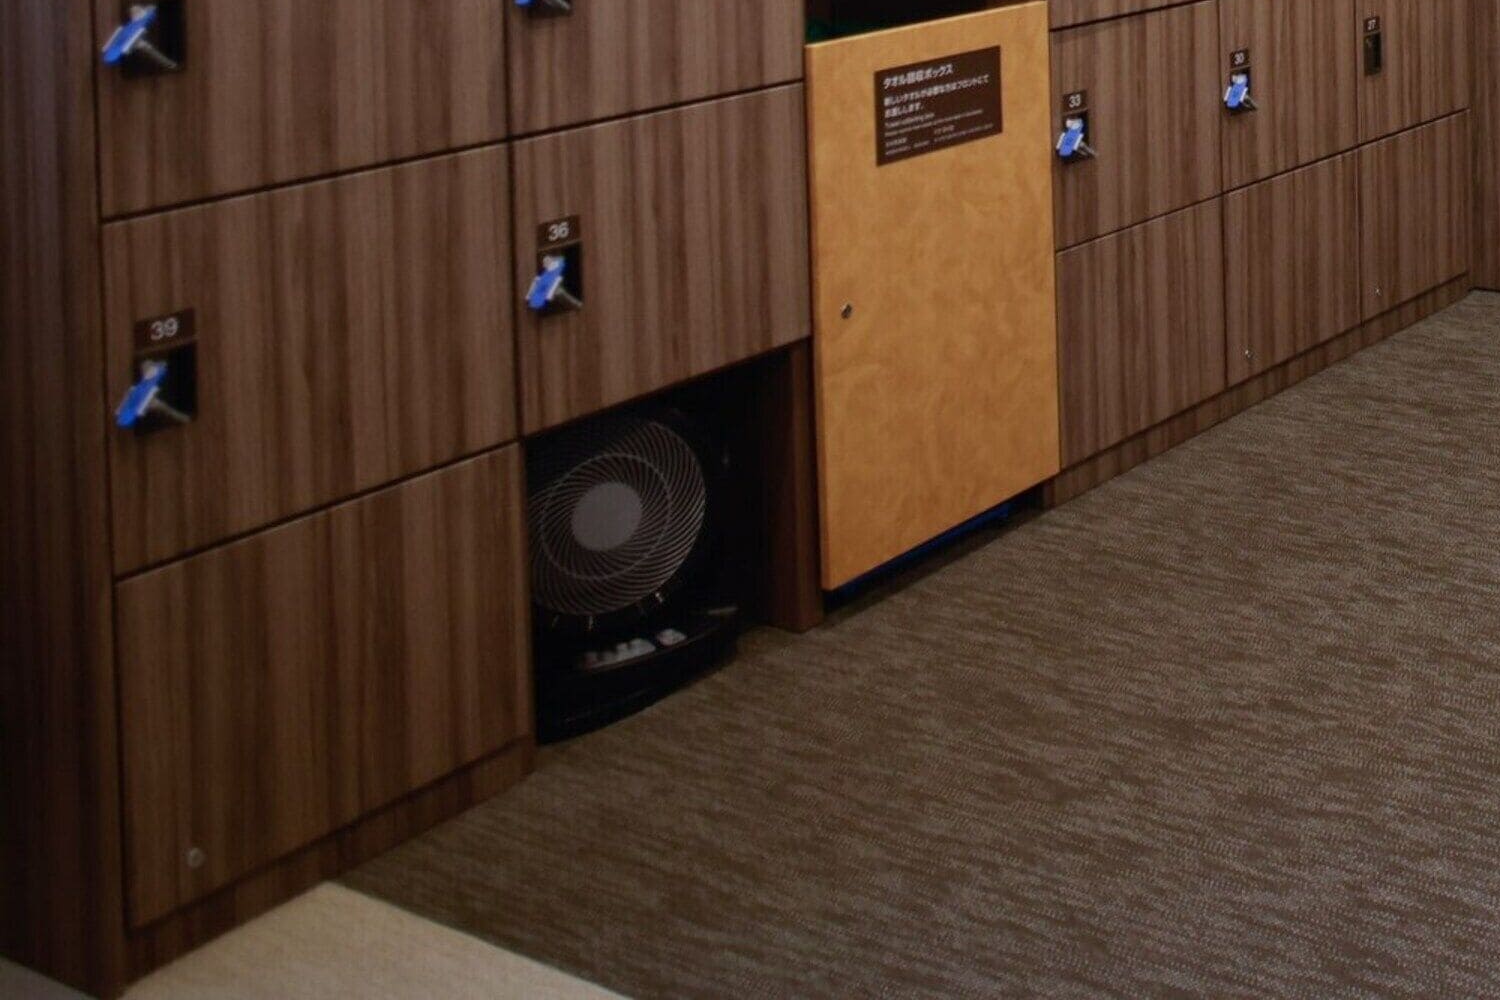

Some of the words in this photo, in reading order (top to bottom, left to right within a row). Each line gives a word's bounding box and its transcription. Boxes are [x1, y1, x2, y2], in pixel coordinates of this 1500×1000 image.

[1068, 93, 1082, 109] 33
[548, 221, 570, 241] 36
[150, 317, 179, 339] 39
